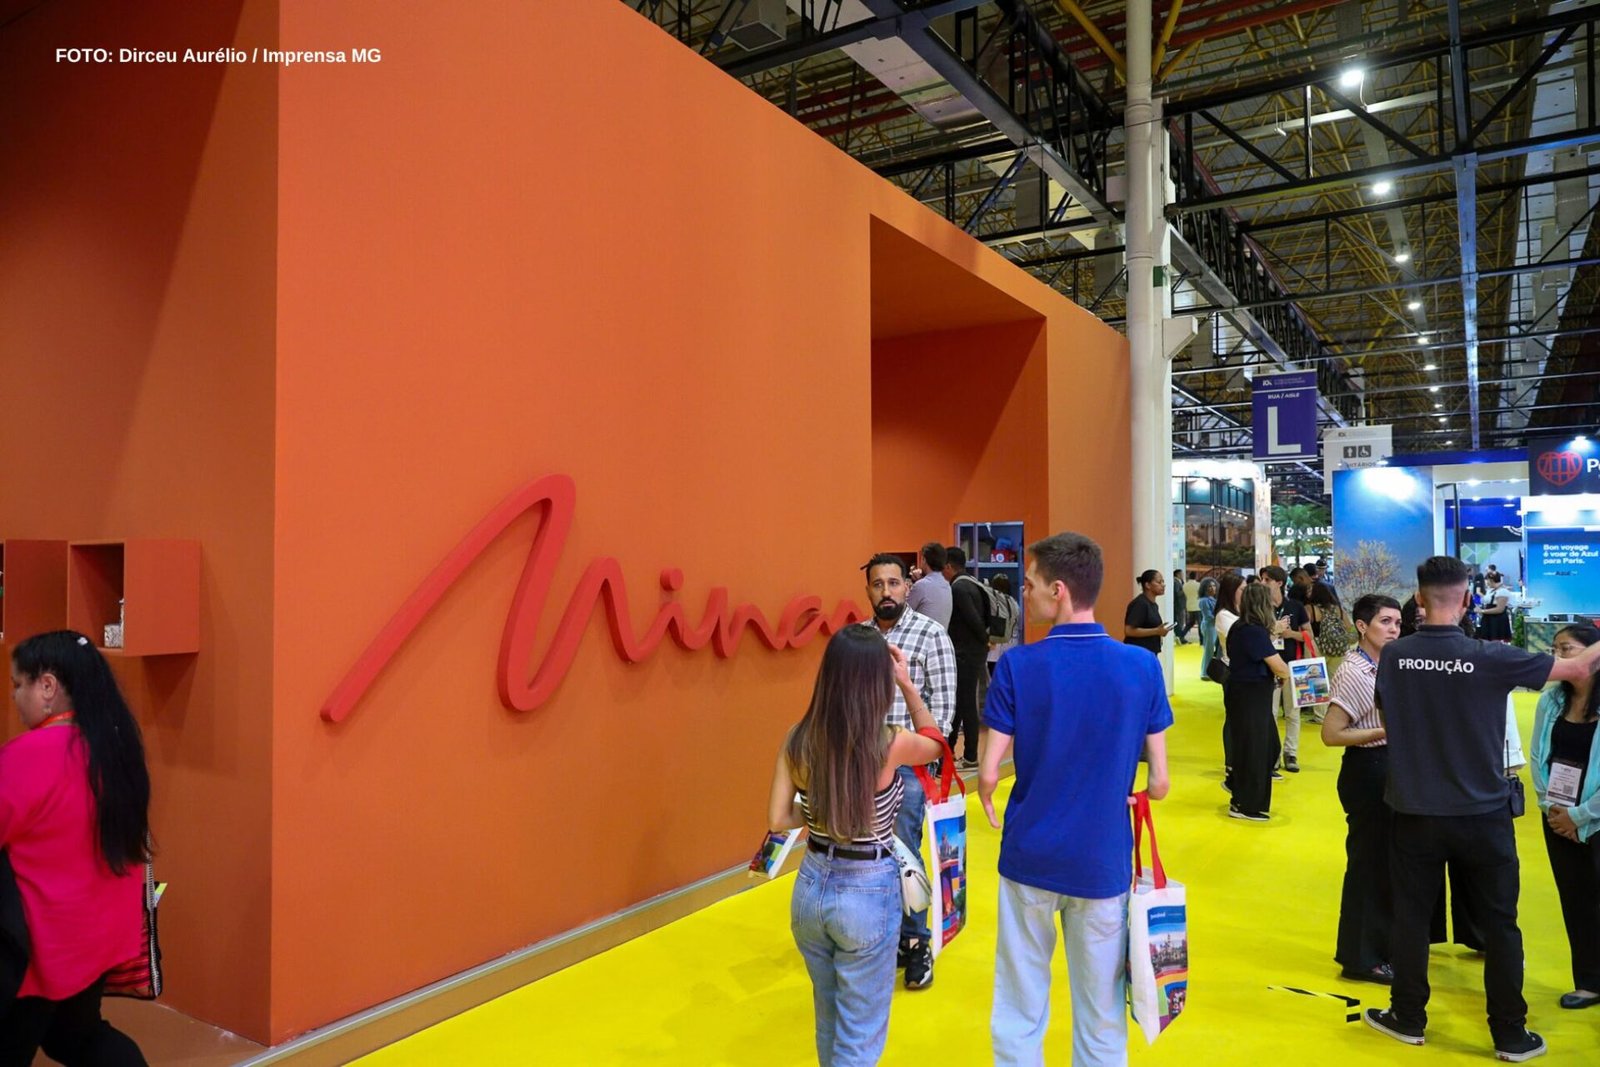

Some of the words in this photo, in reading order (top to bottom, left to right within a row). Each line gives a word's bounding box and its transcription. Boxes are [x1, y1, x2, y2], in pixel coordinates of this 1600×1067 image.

[1267, 406, 1301, 455] L
[1587, 458, 1600, 473] P
[1398, 658, 1475, 675] PRODUÇÃO
